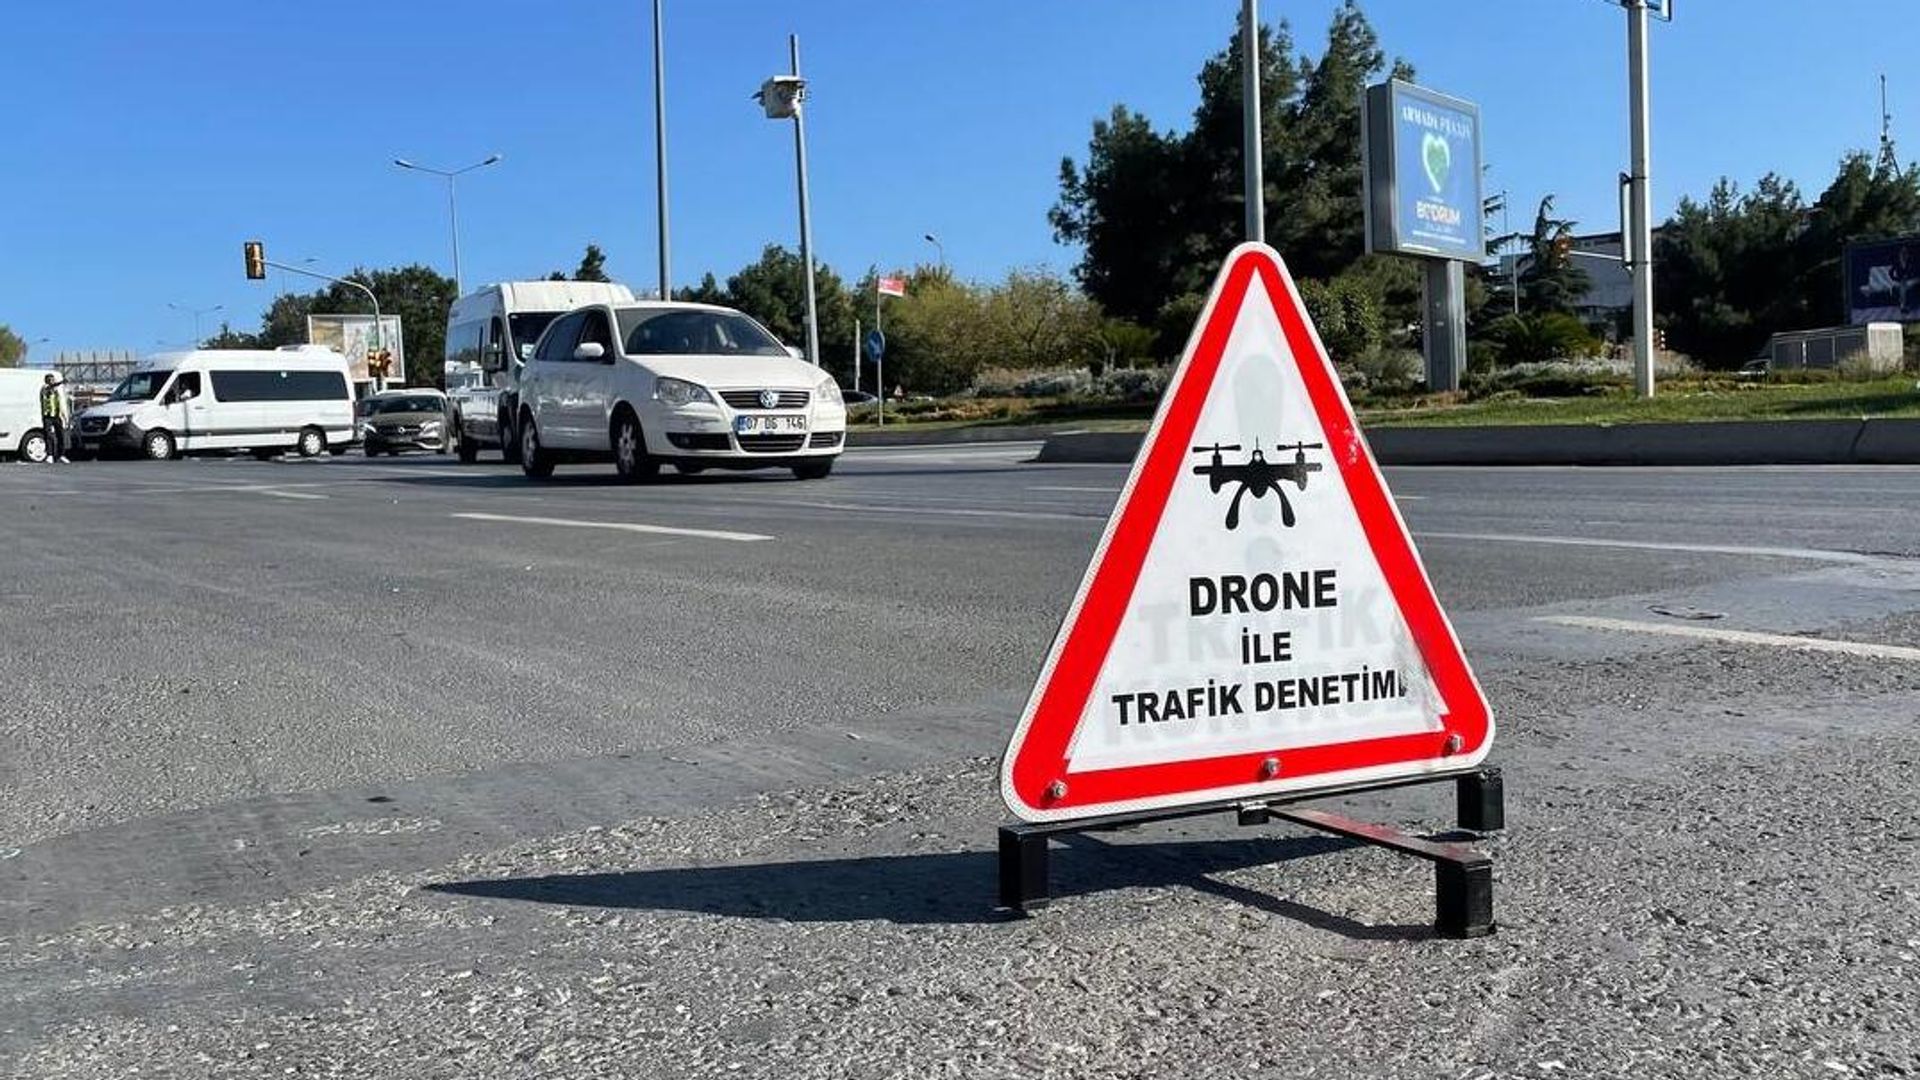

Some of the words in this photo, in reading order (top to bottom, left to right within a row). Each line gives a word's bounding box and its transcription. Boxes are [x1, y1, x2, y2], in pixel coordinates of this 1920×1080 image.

[1189, 569, 1337, 617] DRONE
[1241, 627, 1292, 665] İLE
[1112, 678, 1244, 726] TRAFİK
